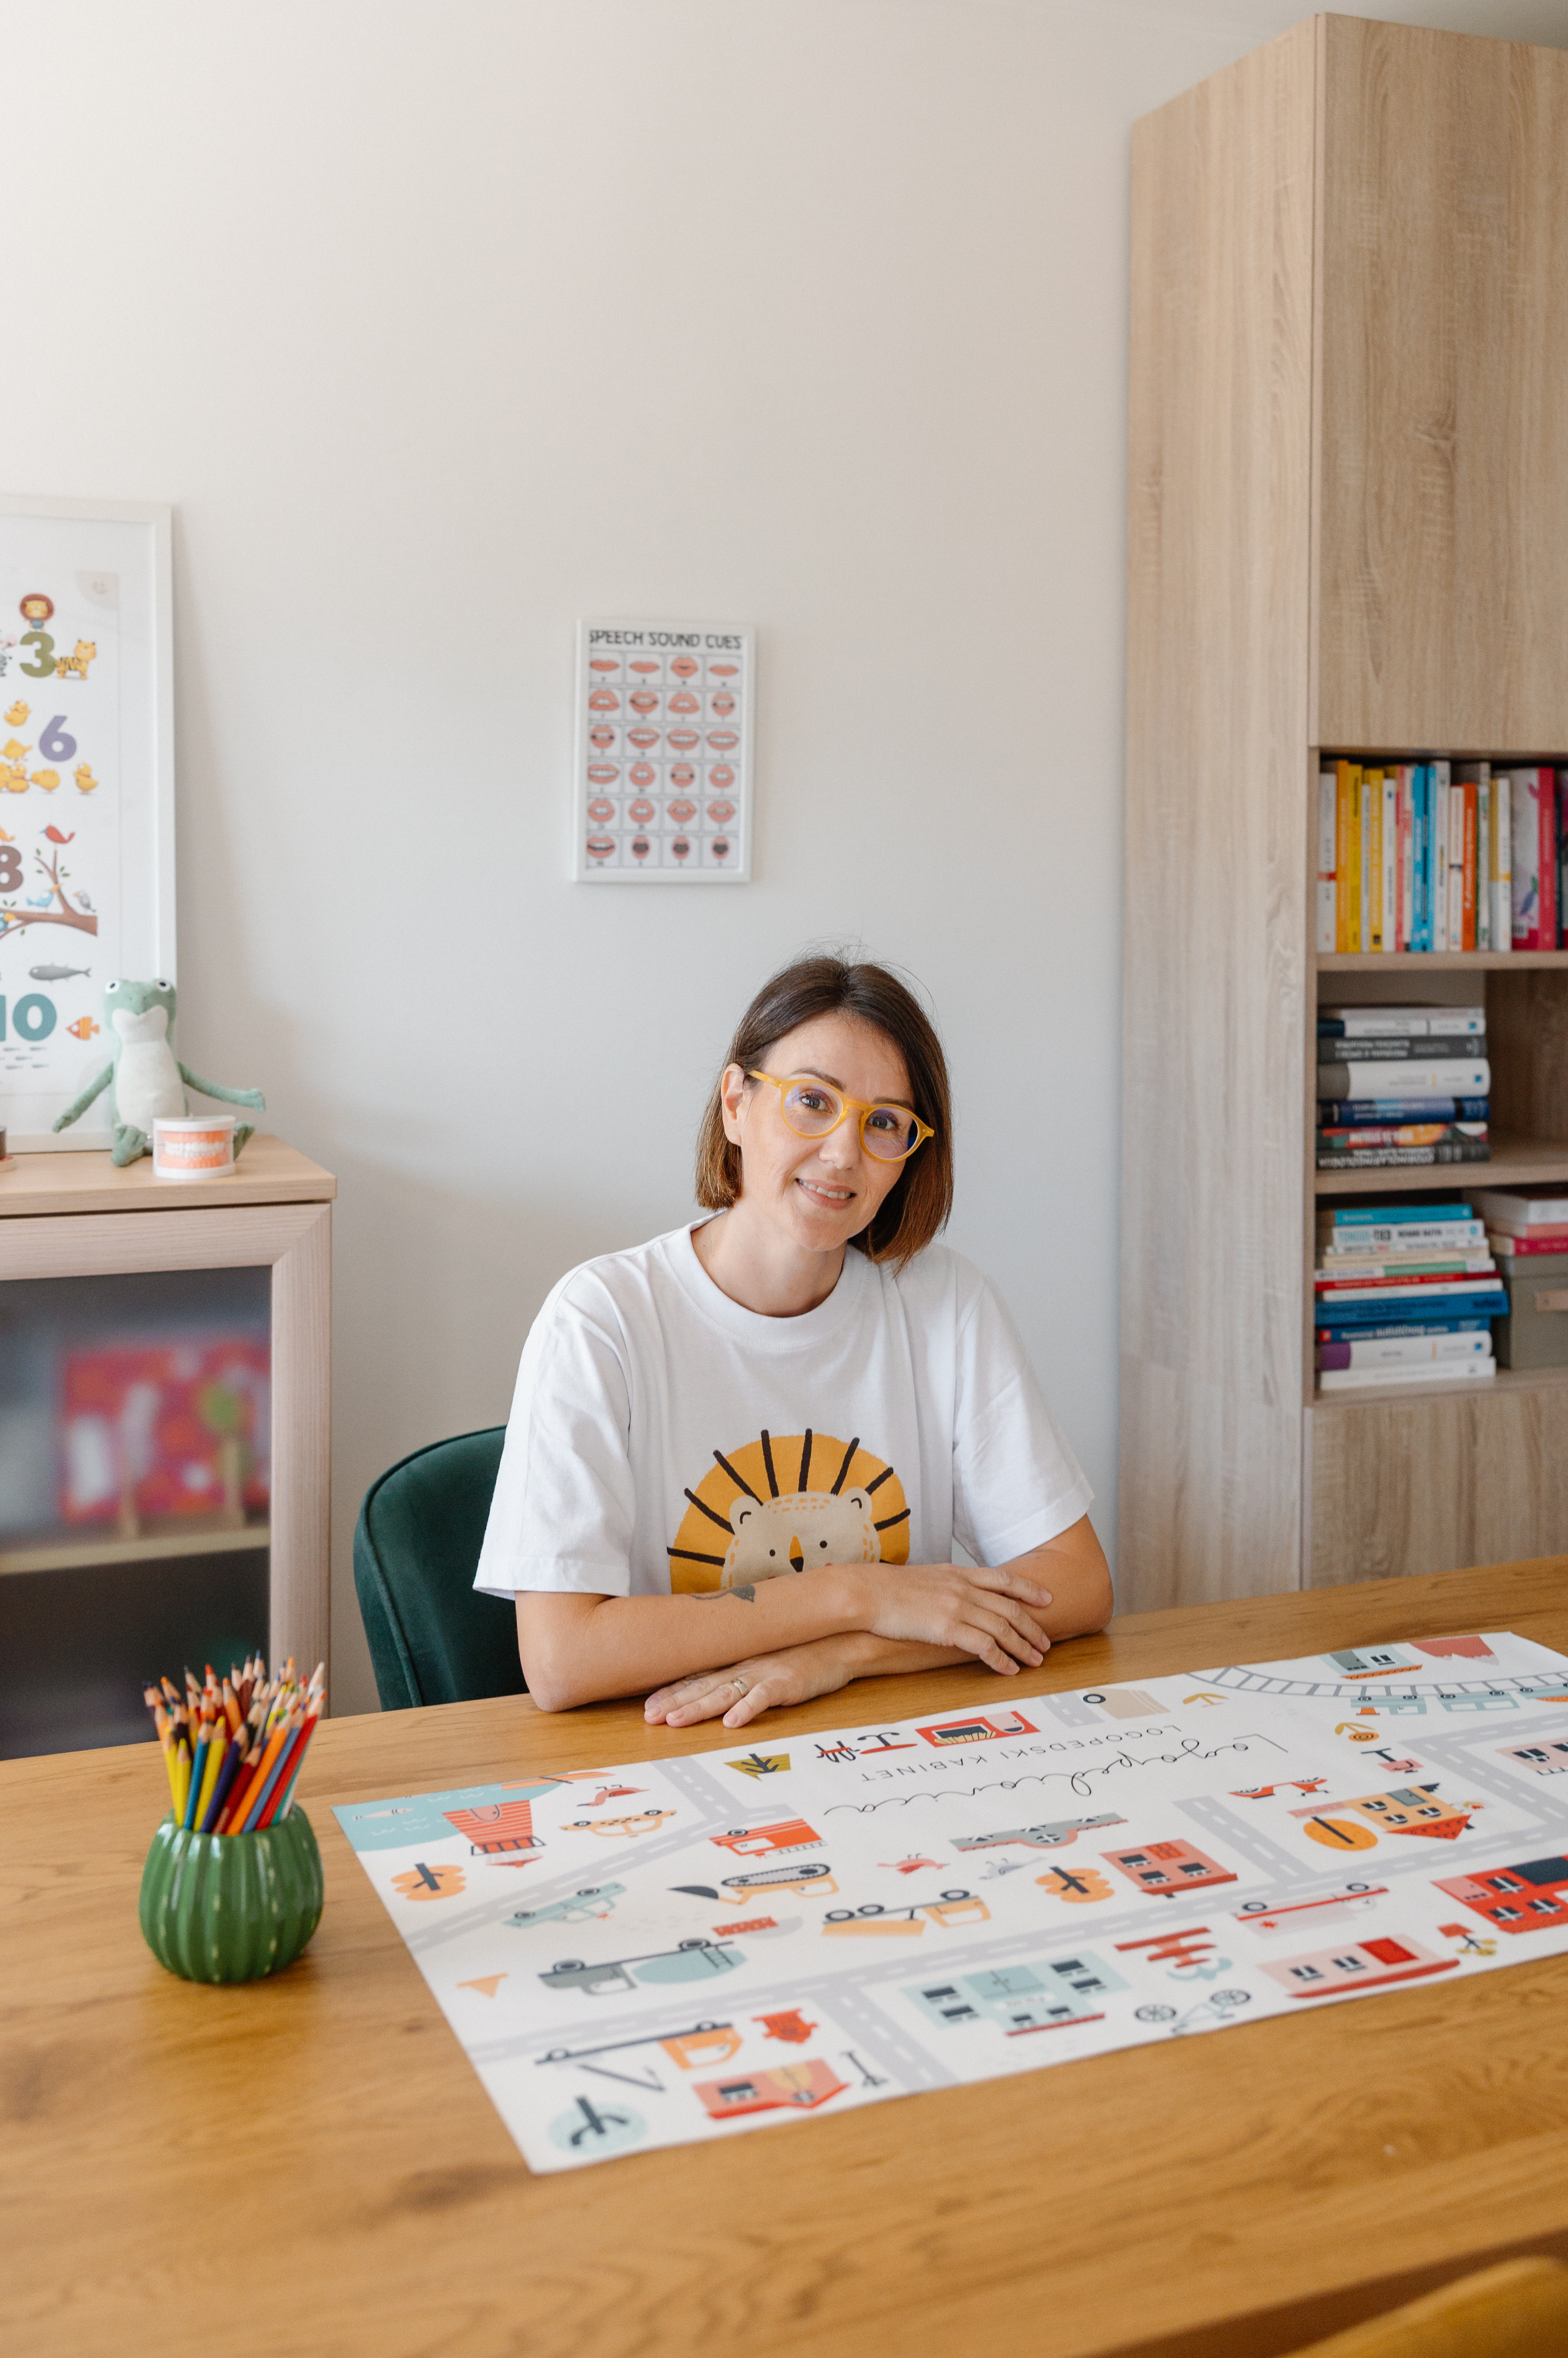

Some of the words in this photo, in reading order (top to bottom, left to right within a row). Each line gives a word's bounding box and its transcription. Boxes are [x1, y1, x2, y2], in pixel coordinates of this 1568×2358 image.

[20, 631, 56, 677] 3
[590, 630, 643, 645] SPEECH
[649, 632, 700, 647] SOUND
[705, 634, 742, 649] CUES
[39, 715, 77, 763] 6
[0, 846, 23, 892] 8
[1000, 1725, 1181, 1760] LOGOPEDSKI
[823, 1733, 1288, 1815] Logopedionica
[861, 1755, 988, 1782] KABINET
